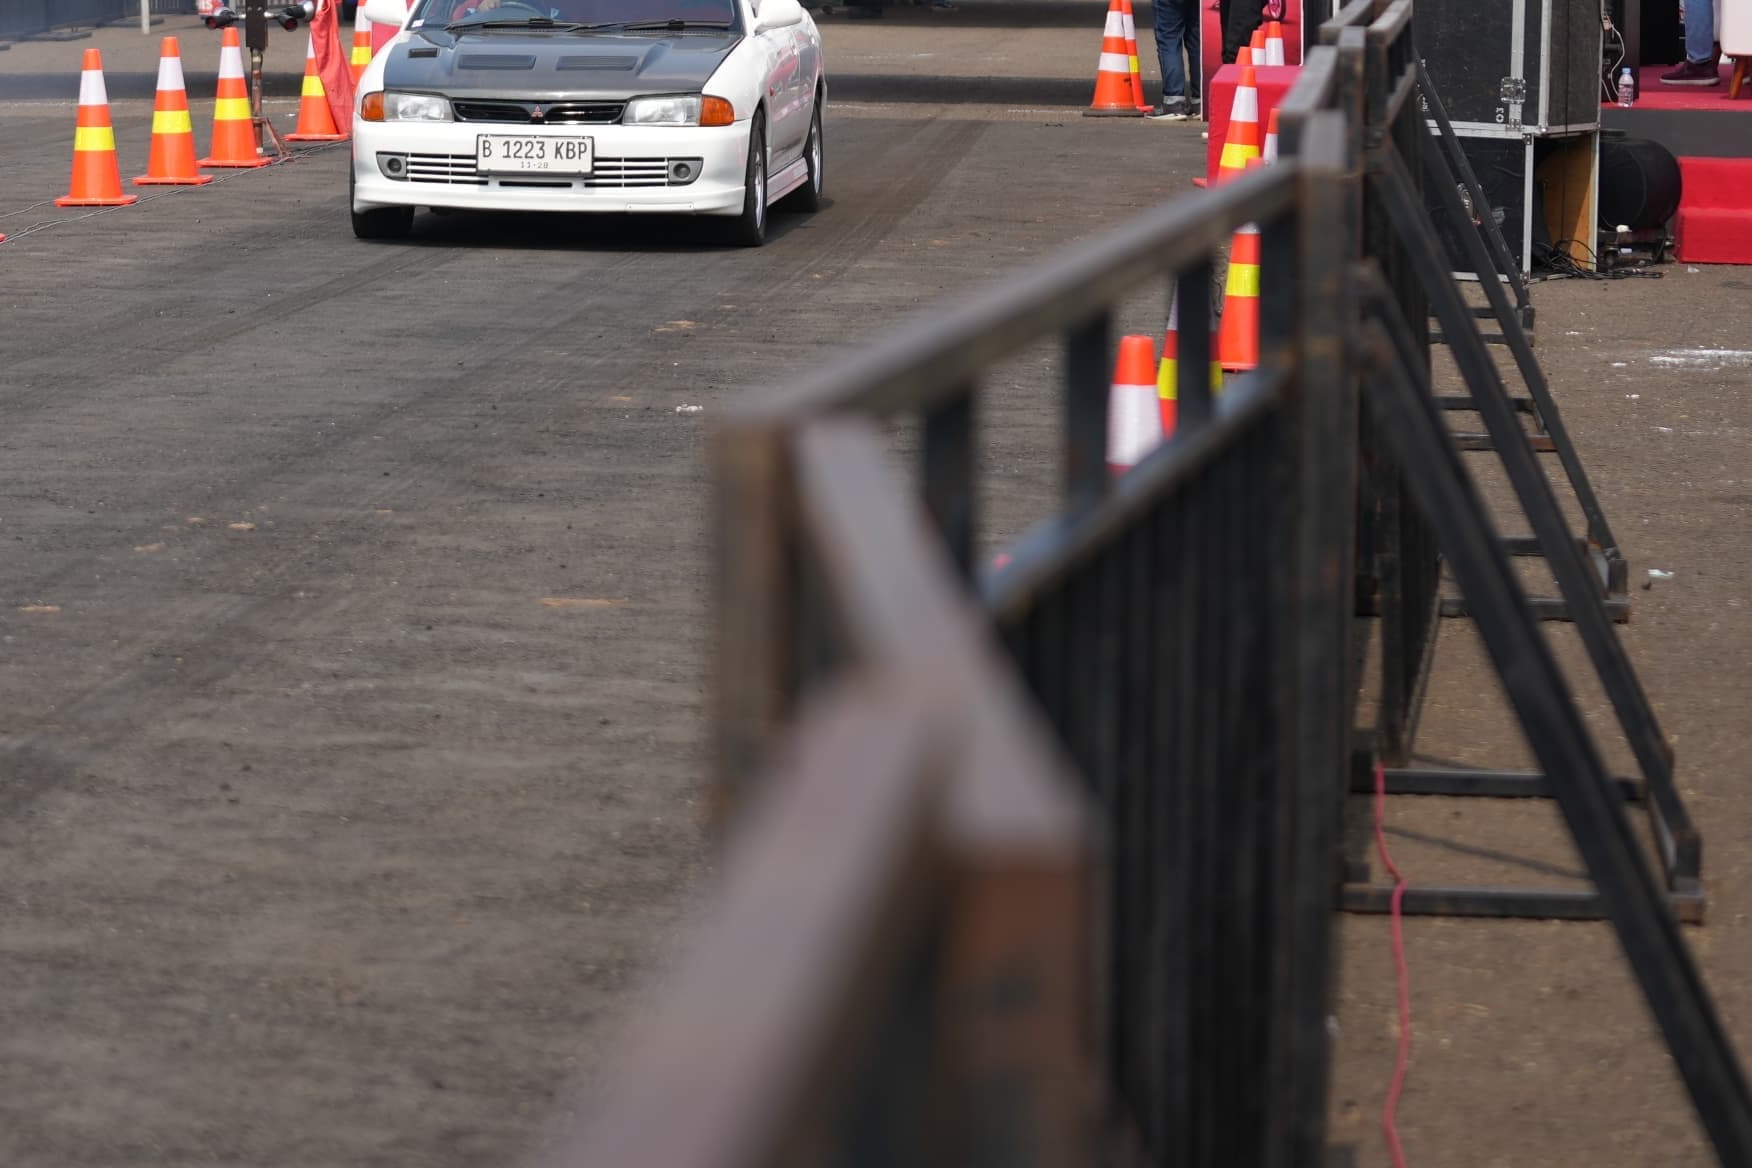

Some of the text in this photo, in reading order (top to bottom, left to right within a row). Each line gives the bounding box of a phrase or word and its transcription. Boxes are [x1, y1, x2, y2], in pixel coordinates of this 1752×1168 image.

[482, 139, 588, 160] B 1223 KBP
